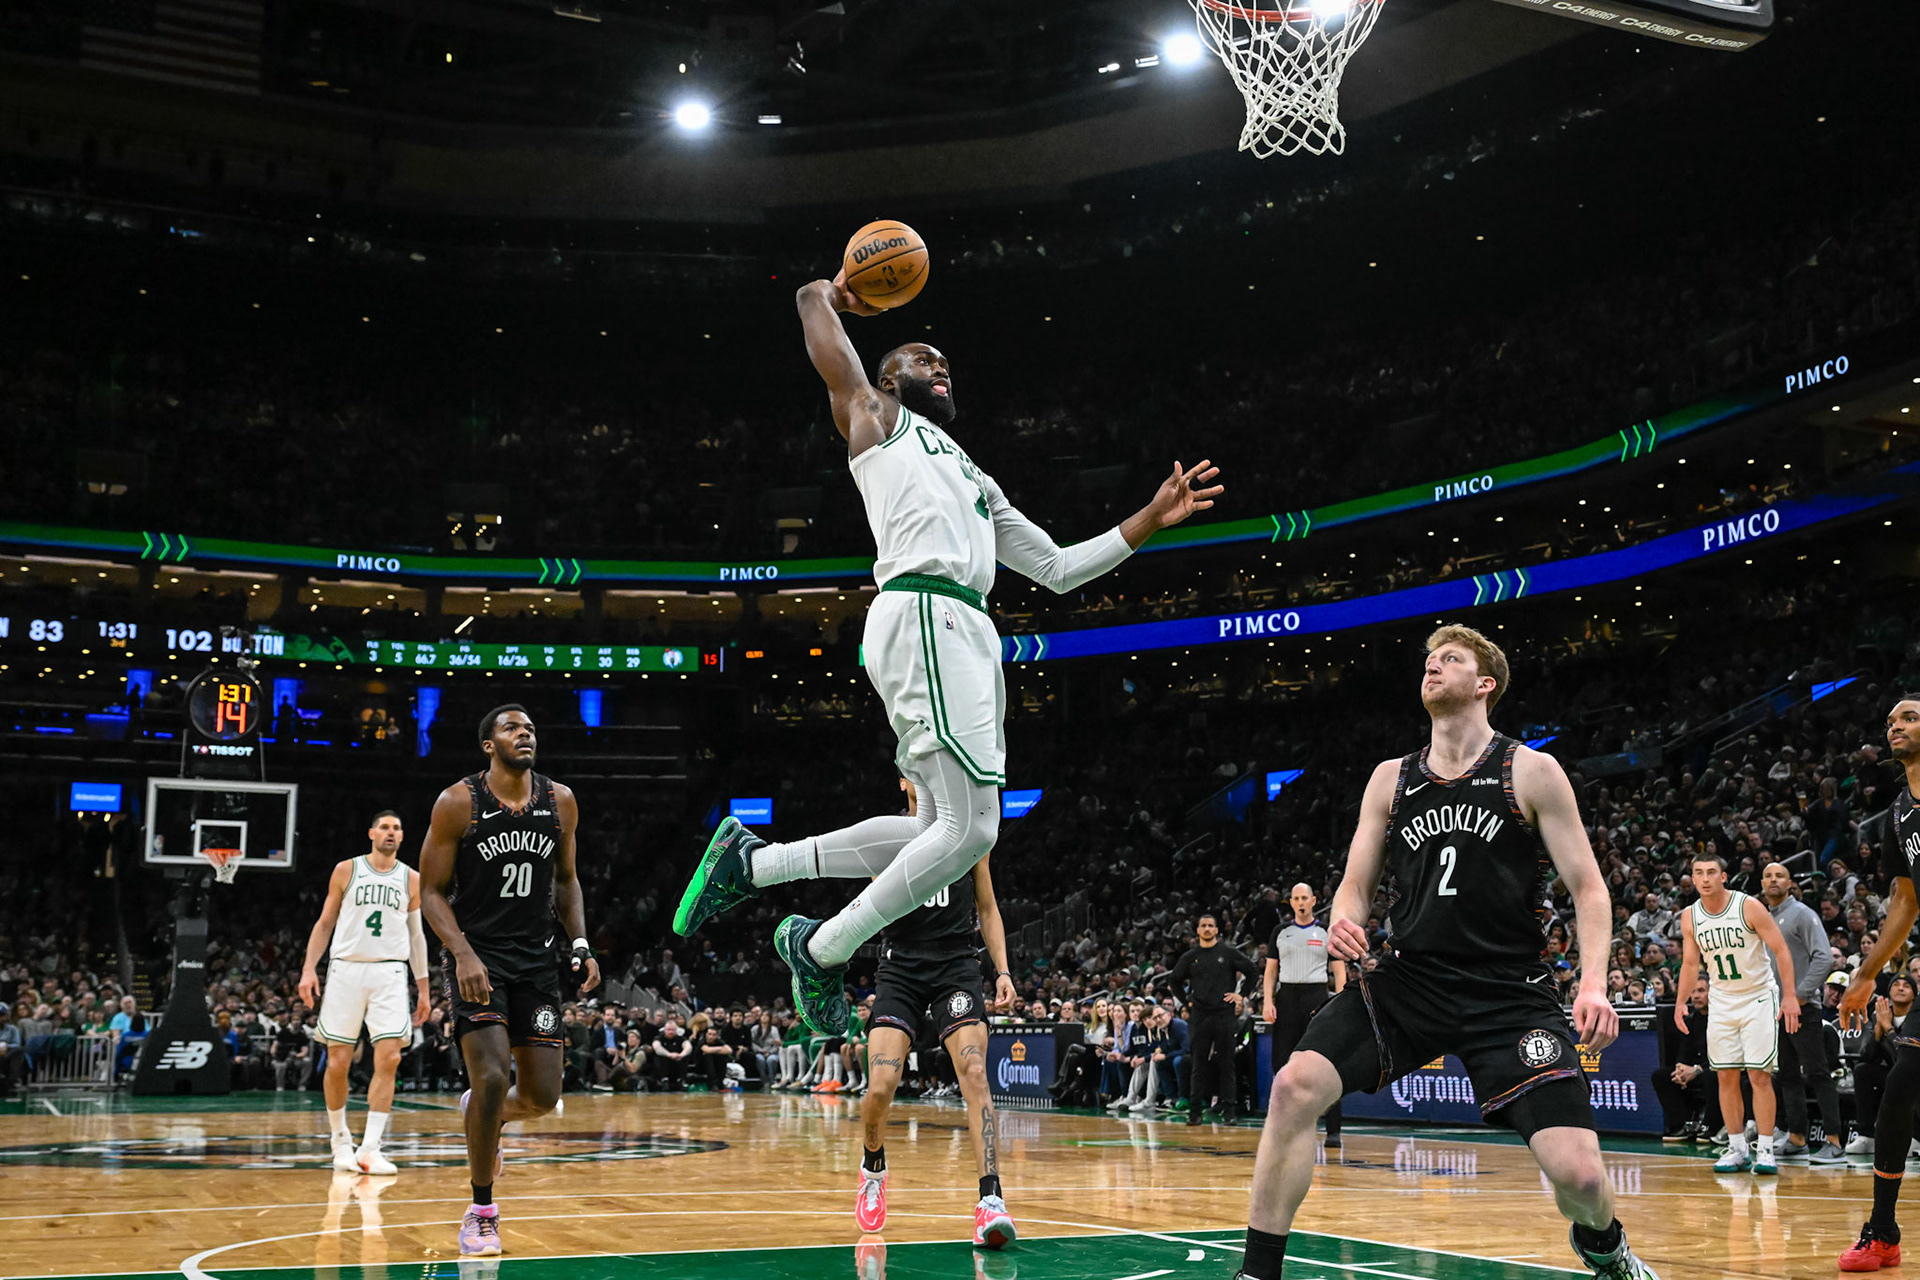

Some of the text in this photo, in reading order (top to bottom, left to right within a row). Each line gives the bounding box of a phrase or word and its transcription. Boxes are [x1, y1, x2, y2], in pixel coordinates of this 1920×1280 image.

[1580, 8, 1620, 21] ENERGY
[1649, 23, 1685, 37] ENERGY
[1711, 39, 1748, 49] ENERGY
[853, 237, 909, 264] Wilson
[1785, 355, 1849, 393] PIMCO
[1434, 475, 1493, 501] PIMCO
[1702, 509, 1780, 551] PIMCO
[336, 554, 400, 573] PIMCO
[719, 565, 779, 581] PIMCO
[29, 619, 64, 642] 83
[98, 621, 138, 639] 1:31
[1219, 611, 1300, 638] PIMCO
[165, 628, 213, 652] 102
[222, 633, 285, 657] BOTON
[369, 650, 378, 662] 3
[394, 651, 404, 664] 5
[415, 653, 437, 665] 66.7
[449, 654, 481, 666] 36/54
[497, 655, 529, 667] 16/26
[544, 655, 554, 668] 9
[572, 656, 582, 669] 5
[598, 656, 613, 669] 30
[626, 656, 641, 669] 29
[703, 653, 718, 666] 15
[216, 701, 246, 734] 14
[208, 745, 254, 757] TISSOT
[1400, 803, 1505, 852] BROOKLYN
[476, 830, 556, 862] BROOKLYN
[500, 862, 533, 898] 20
[1438, 845, 1458, 896] 2
[355, 884, 402, 910] CELTICS
[366, 911, 382, 937] 4
[1697, 926, 1745, 953] CELTICS
[1713, 953, 1742, 981] 11
[1534, 1039, 1545, 1057] B
[997, 1057, 1040, 1092] Corona
[1391, 1073, 1475, 1113] Corona
